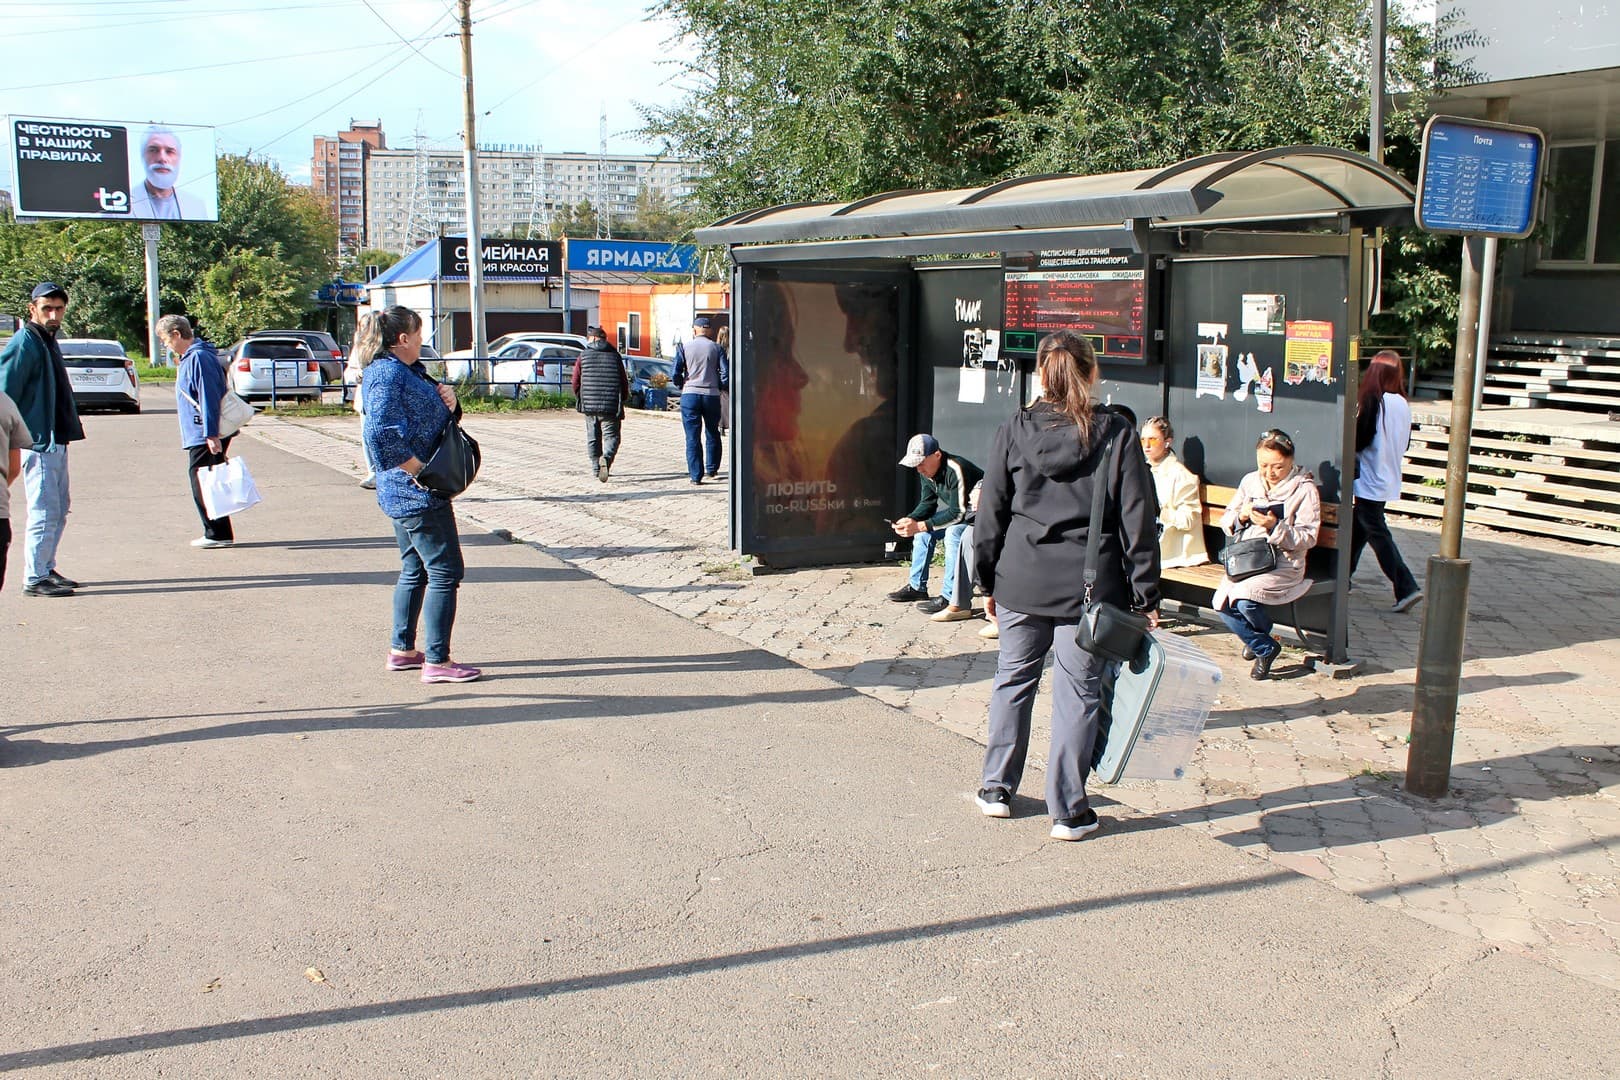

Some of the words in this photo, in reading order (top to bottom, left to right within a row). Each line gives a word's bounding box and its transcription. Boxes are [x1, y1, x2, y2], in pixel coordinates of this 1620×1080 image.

[18, 123, 112, 138] ЧЕСТНОСТЬ
[18, 136, 30, 147] В
[35, 138, 93, 150] НАШИХ
[1473, 135, 1493, 146] Почта
[20, 149, 102, 163] ПРАВИЛАХ
[98, 187, 128, 211] t2
[454, 243, 549, 261] СМЕЙНАЯ
[587, 249, 682, 268] ЯРМАРКА
[1040, 249, 1076, 258] РАСПИСАНИЕ
[1077, 248, 1110, 257] ДВИЖЕНИЯ
[454, 262, 498, 272] СТИЯ
[500, 263, 549, 273] КРАСОТЫ
[1040, 257, 1089, 266] ОБЩЕСТВЕННОГО
[1090, 256, 1129, 265] ТРАНСПОРТА
[1112, 271, 1143, 279] ОЖИДАНИЕ
[766, 480, 838, 497] ЛЮБИТЬ
